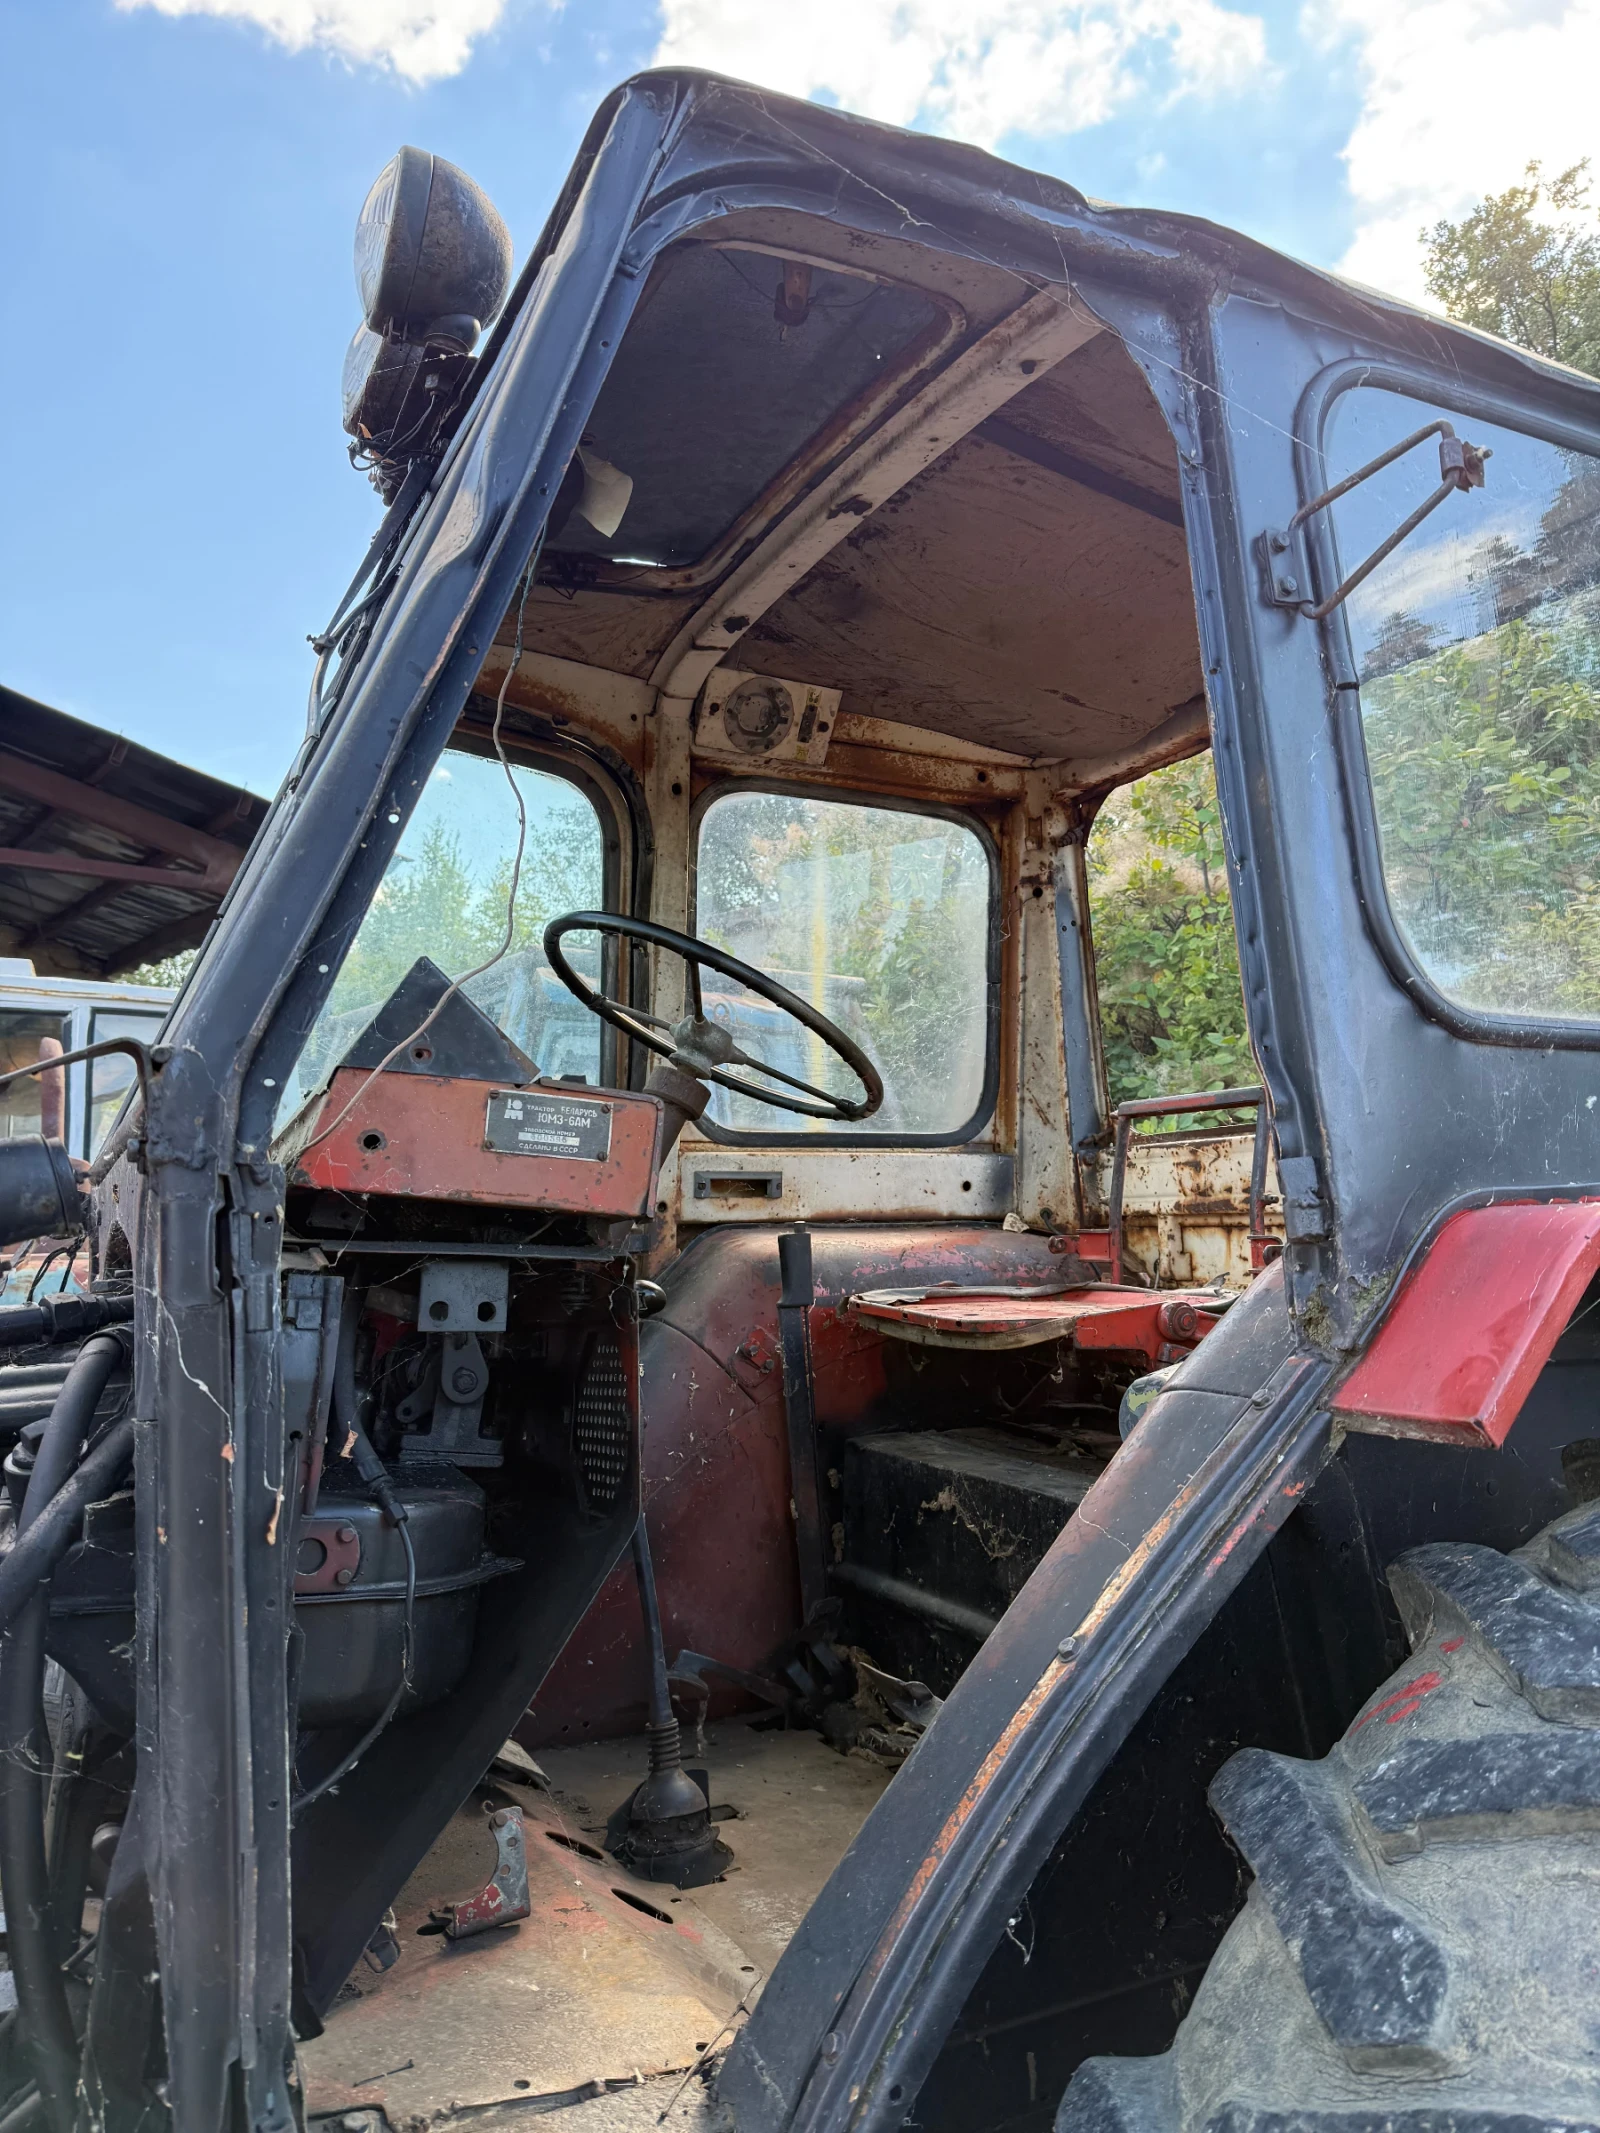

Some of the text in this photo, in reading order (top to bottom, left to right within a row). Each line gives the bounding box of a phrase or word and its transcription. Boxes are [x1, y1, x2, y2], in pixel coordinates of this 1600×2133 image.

[527, 1105, 598, 1117] ТРАКТОР БЕЛАРУСЬ
[538, 1113, 591, 1128] ЮМЗ-6АМ
[518, 1142, 551, 1151] СДЕЛАНО
[559, 1146, 578, 1154] СССР
